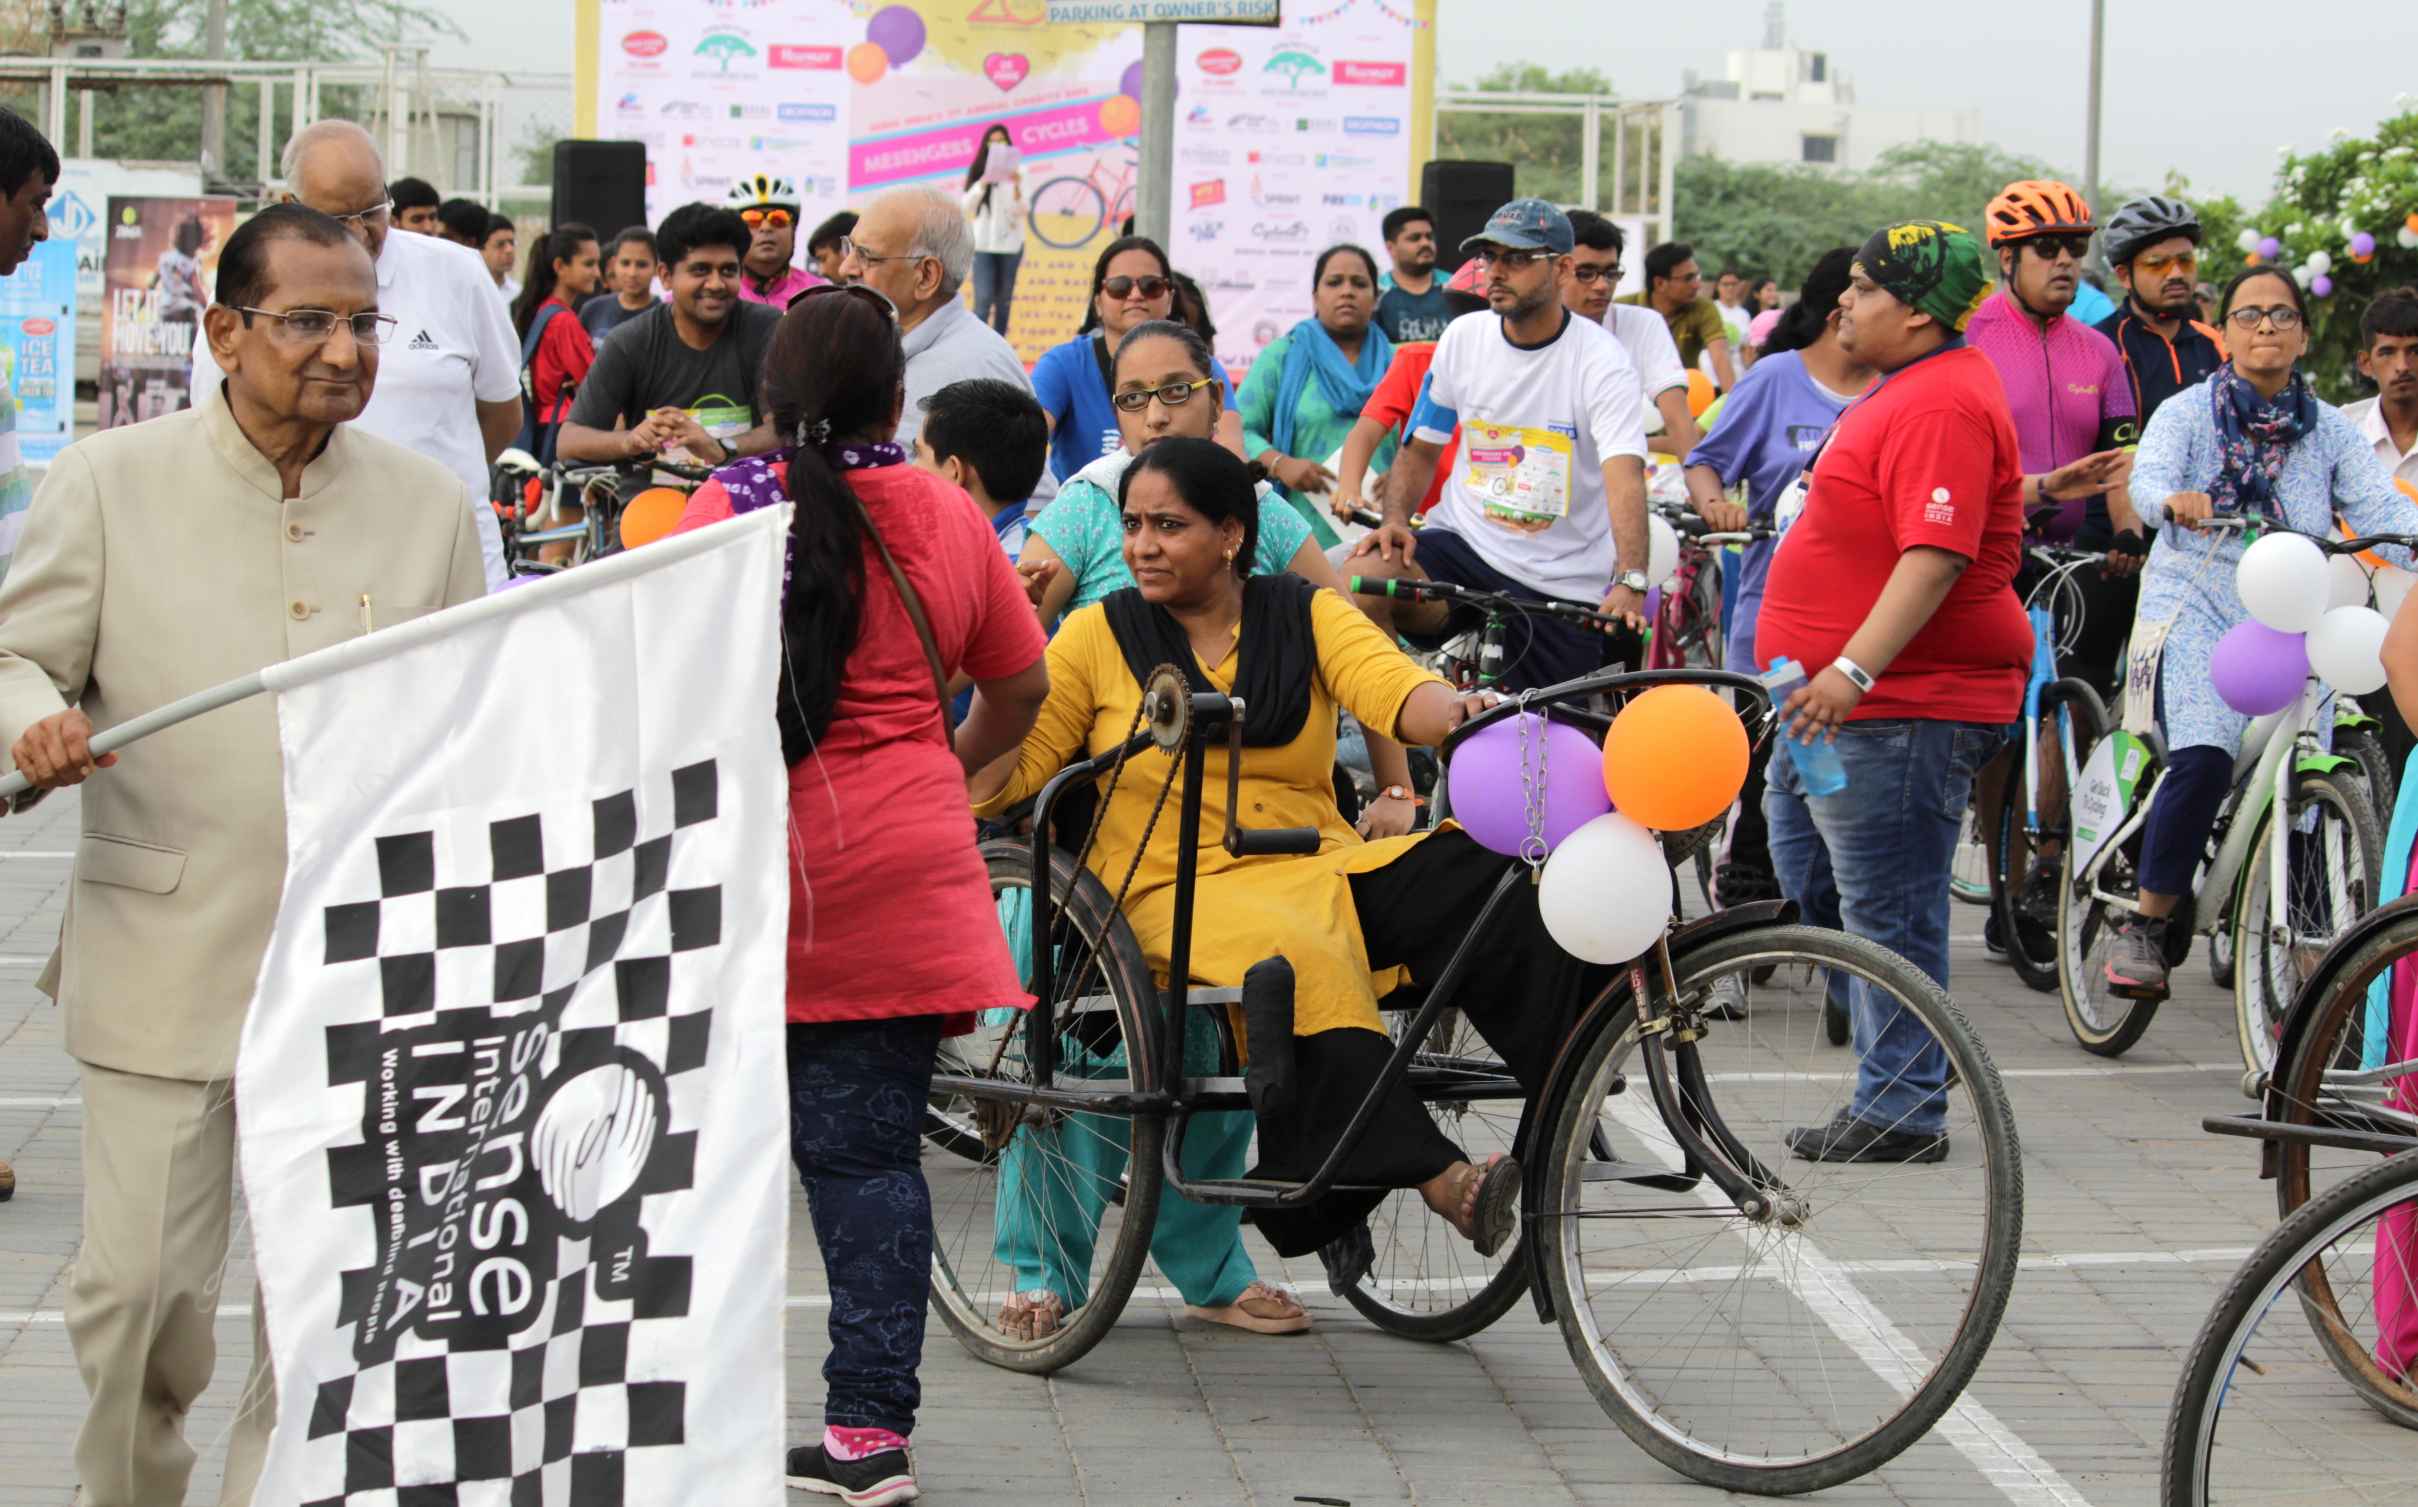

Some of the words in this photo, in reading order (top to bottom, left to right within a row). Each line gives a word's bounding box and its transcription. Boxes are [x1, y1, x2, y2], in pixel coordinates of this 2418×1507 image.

[1050, 4, 1124, 21] PARKING
[1129, 4, 1148, 19] AT
[1153, 1, 1233, 18] OWNER'S
[1237, 0, 1275, 16] RISK
[1021, 116, 1089, 145] CYCLES
[112, 288, 141, 320] LET
[21, 338, 53, 356] ICE
[160, 320, 190, 355] YOU
[20, 357, 54, 375] TEA
[379, 1048, 399, 1134] Working
[385, 1140, 405, 1182] with
[426, 1035, 506, 1322] International
[382, 1187, 406, 1277] deafblind
[610, 1245, 634, 1283] TM
[363, 1280, 388, 1344] people
